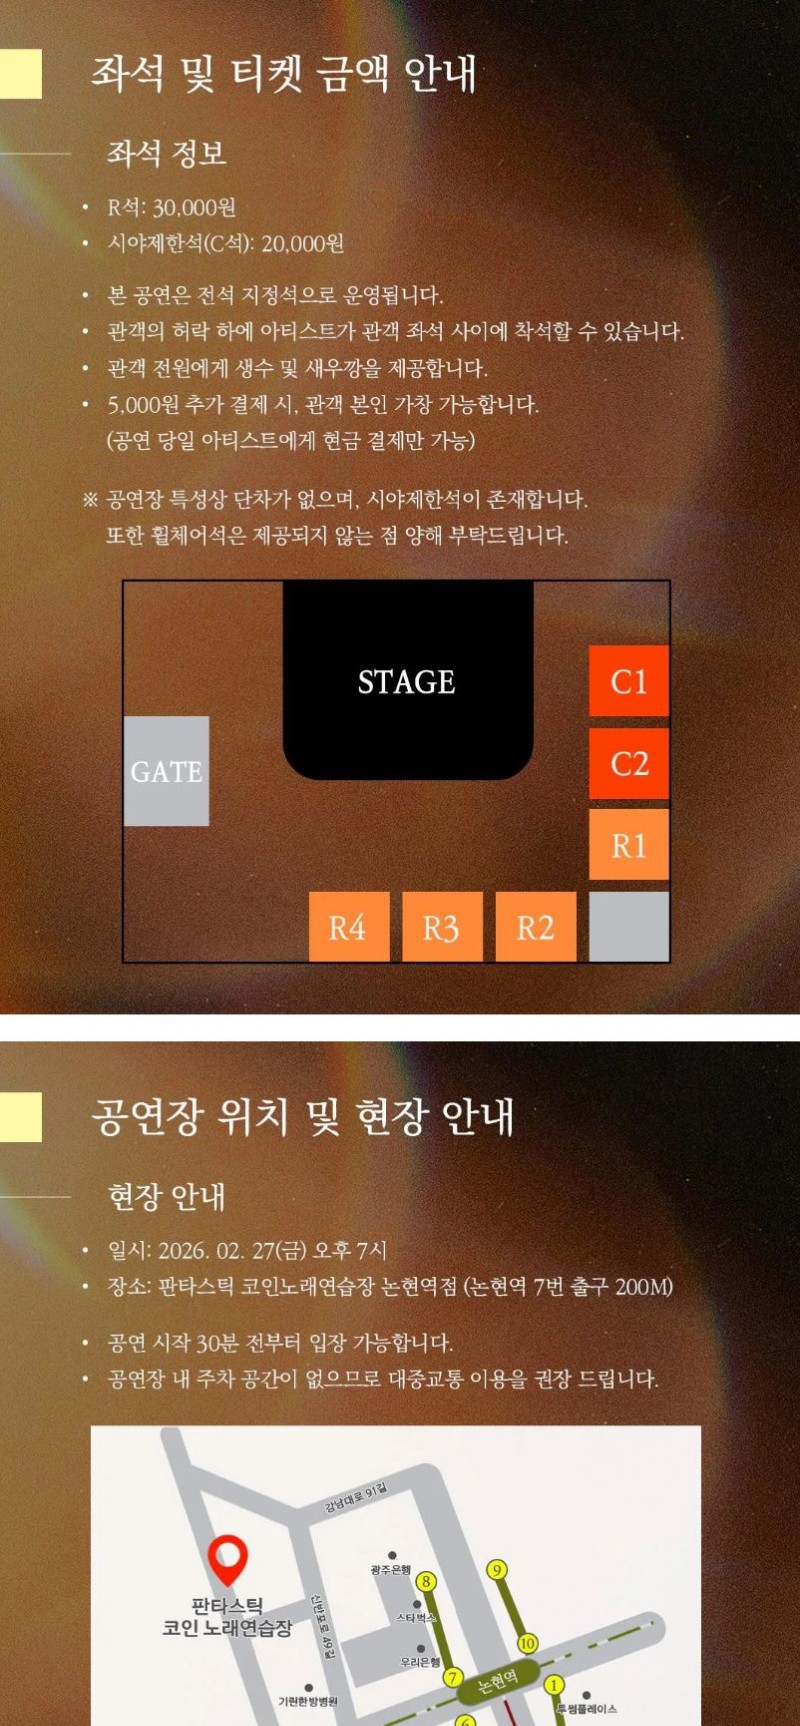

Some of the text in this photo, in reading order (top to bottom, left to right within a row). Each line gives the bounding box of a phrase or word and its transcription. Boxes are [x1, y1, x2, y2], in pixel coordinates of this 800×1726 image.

[91, 53, 476, 94] 좌석 및 티켓 금액 안내
[107, 139, 227, 169] 좌석 정보
[108, 196, 236, 219] R석: 30,000원
[108, 232, 345, 255] 시야제한석(C석): 20,000원
[107, 284, 444, 306] 본 공연은 전석 지정석으로 운영됩니다.
[358, 668, 456, 694] STAGE
[610, 669, 646, 695] C1
[130, 760, 203, 783] GATE
[611, 750, 649, 777] C2
[613, 833, 645, 859] R1
[330, 912, 365, 941] R4
[424, 914, 459, 944] R3
[518, 914, 555, 941] R2
[91, 1097, 513, 1137] 공연장 위치 및 현장 안내
[107, 1182, 225, 1213] 현장 안내
[108, 1276, 674, 1298] 장소: 판타스틱 코인노래연습장 논현역점 (논현역 7번 출구 200M)
[325, 1481, 388, 1513] 강남대로 91길
[371, 1565, 411, 1575] 광주은행
[192, 1597, 264, 1616] 판타스틱
[397, 1613, 437, 1623] 스타벅스
[162, 1619, 293, 1638] 코인 노래연습장
[310, 1594, 336, 1660] 신반포로 49길
[401, 1657, 440, 1668] 우리은행
[478, 1669, 519, 1695] 논현역
[557, 1704, 618, 1714] 투썸플레이스
